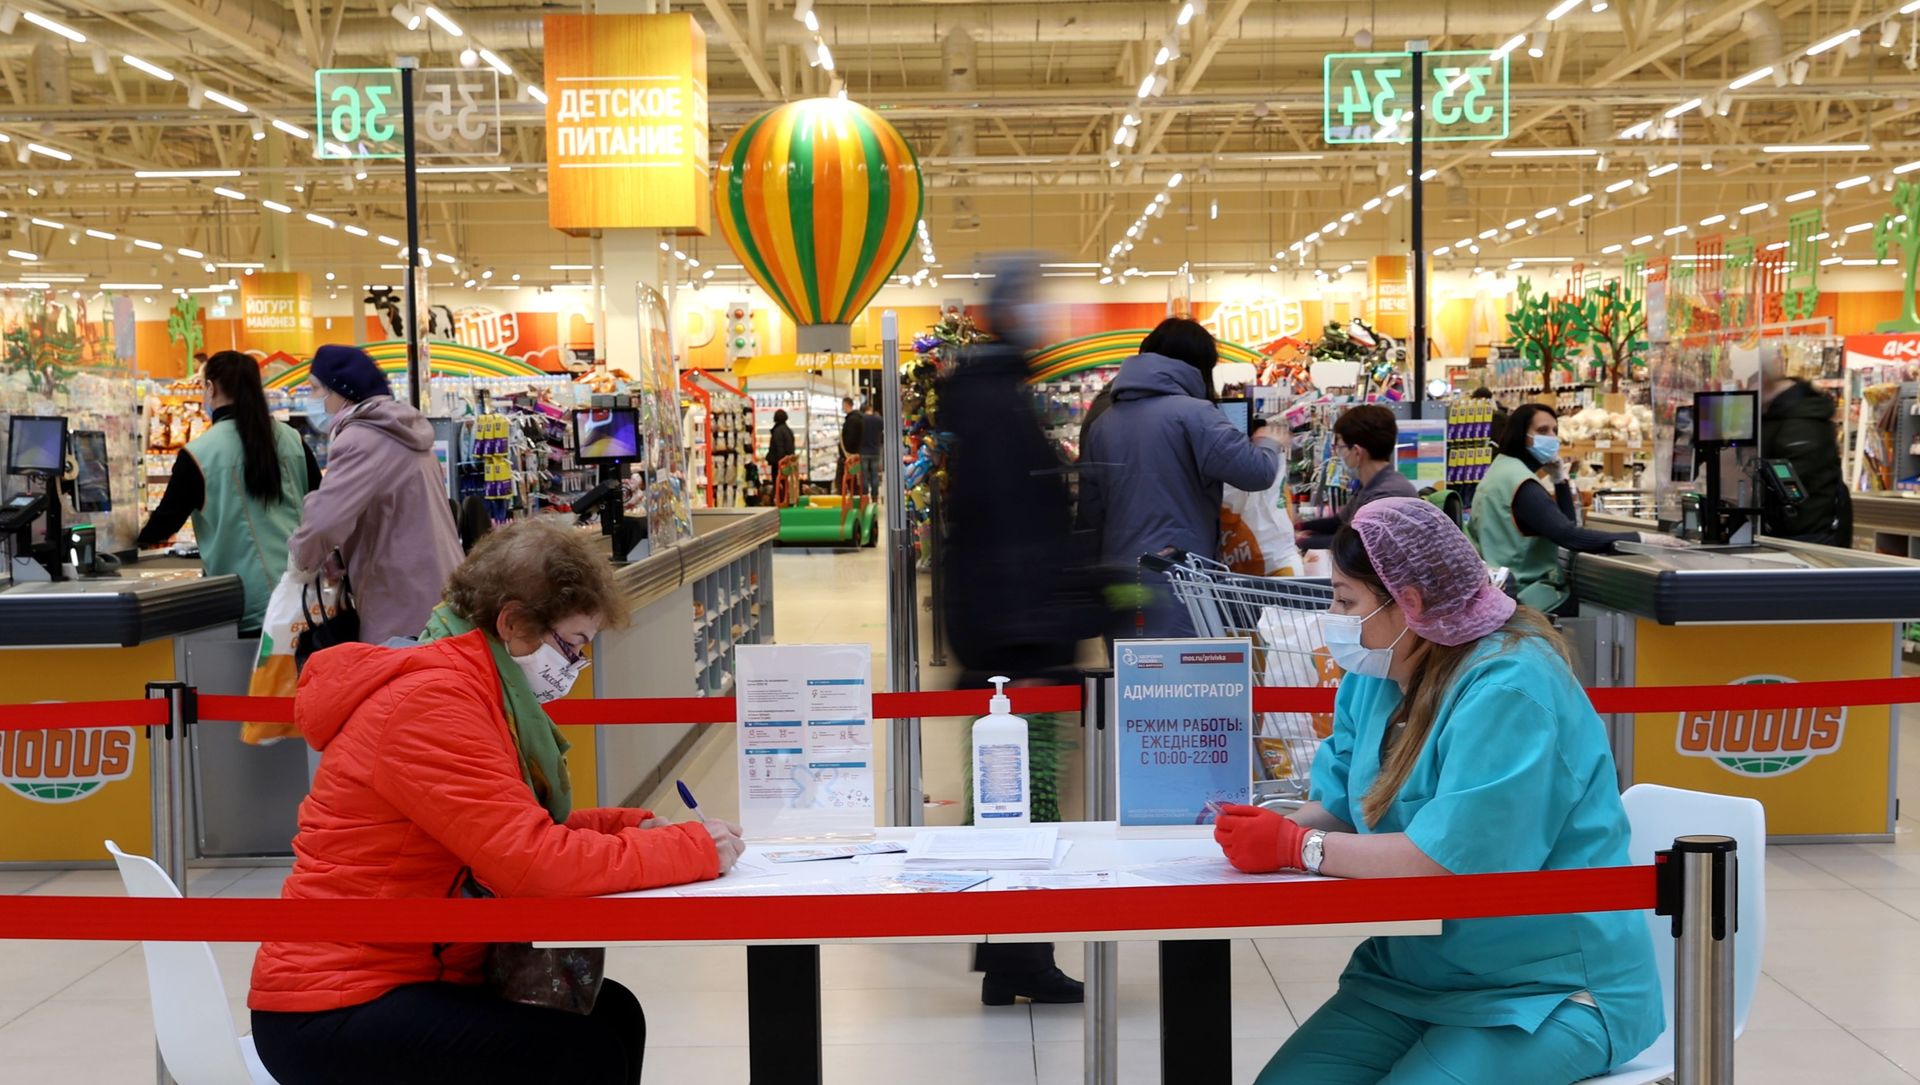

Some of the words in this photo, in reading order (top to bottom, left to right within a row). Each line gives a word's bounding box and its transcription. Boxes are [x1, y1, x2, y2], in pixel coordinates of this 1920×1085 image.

[556, 87, 683, 122] ДЕТСКОЕ
[557, 124, 684, 157] ПИТАНИЕ
[246, 296, 295, 314] ЙОГУРТ
[246, 314, 296, 328] МАЙОНЕЗ
[833, 353, 884, 366] детст
[1182, 653, 1227, 662] mos.ru/privivka
[1123, 683, 1245, 701] АДМИНИСТРАТОР
[1126, 719, 1178, 733] РЕЖИМ
[1183, 717, 1243, 732] РАБОТЫ:
[1142, 734, 1227, 750] ЕЖЕДНЕВНО
[1140, 752, 1150, 765] С
[1154, 750, 1228, 765] 10:00-22:00
